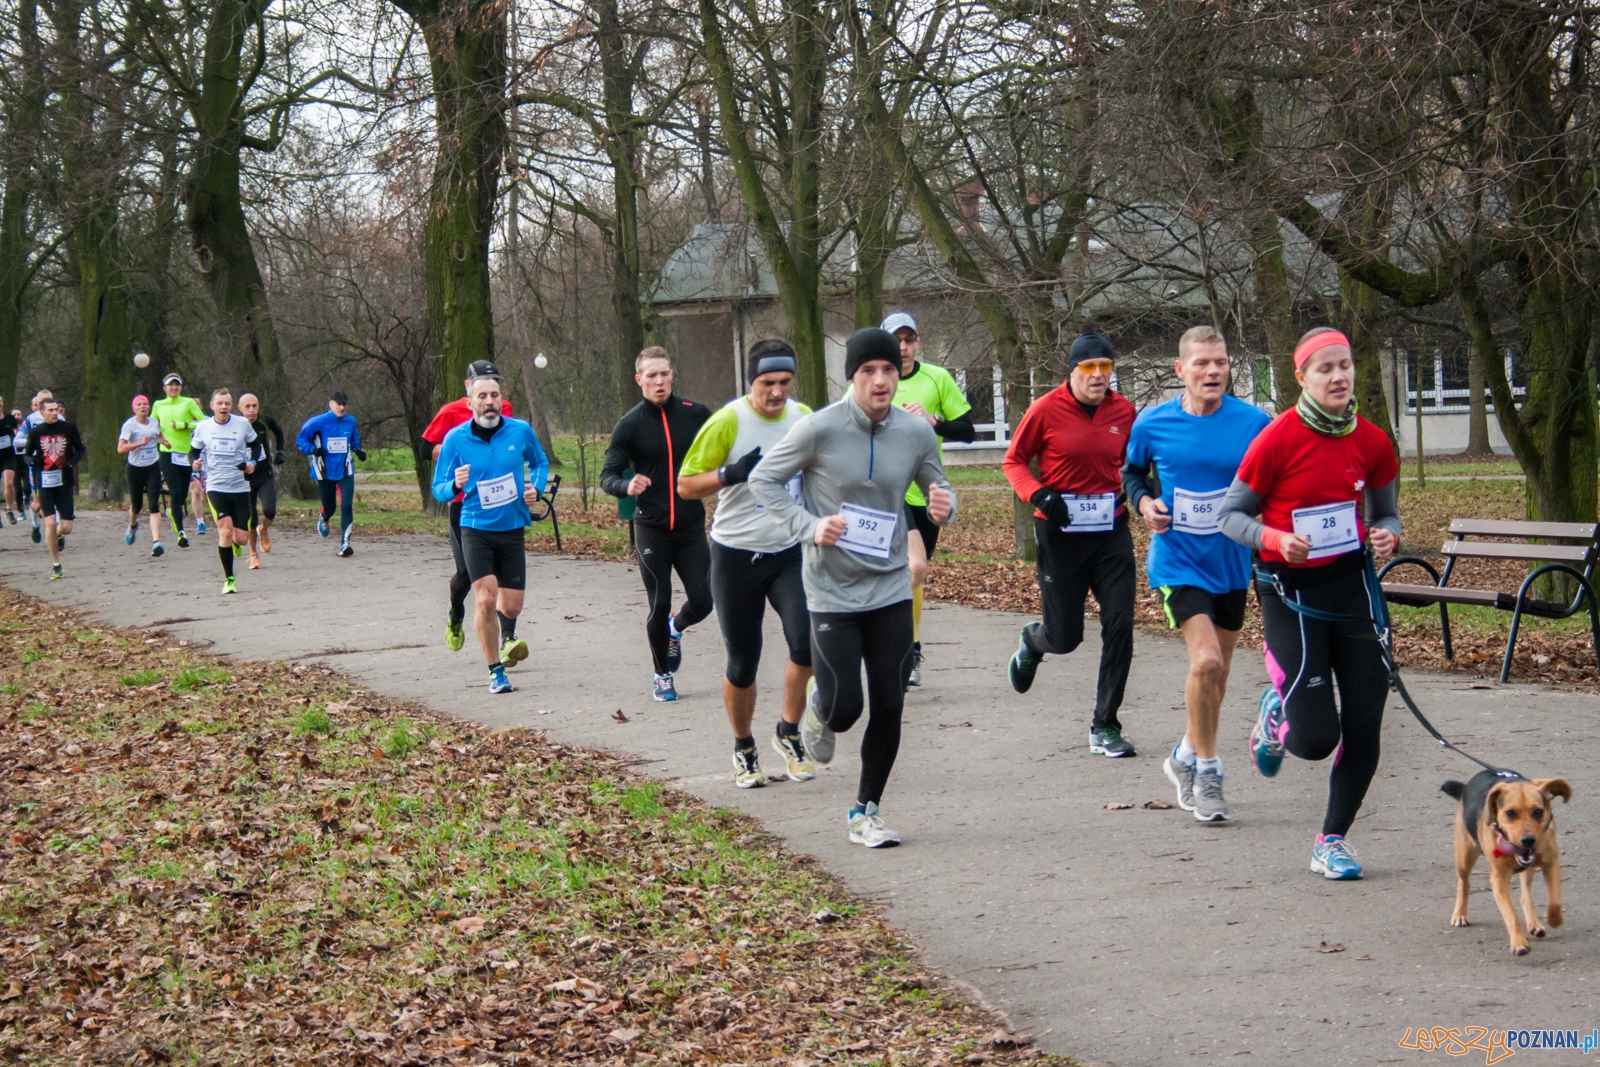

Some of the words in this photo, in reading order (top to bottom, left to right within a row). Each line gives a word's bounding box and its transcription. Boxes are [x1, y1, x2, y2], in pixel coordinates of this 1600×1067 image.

[490, 484, 505, 494] 229
[1079, 502, 1097, 512] 534
[1192, 503, 1213, 514] 665
[857, 518, 878, 531] 952
[1321, 516, 1337, 529] 28
